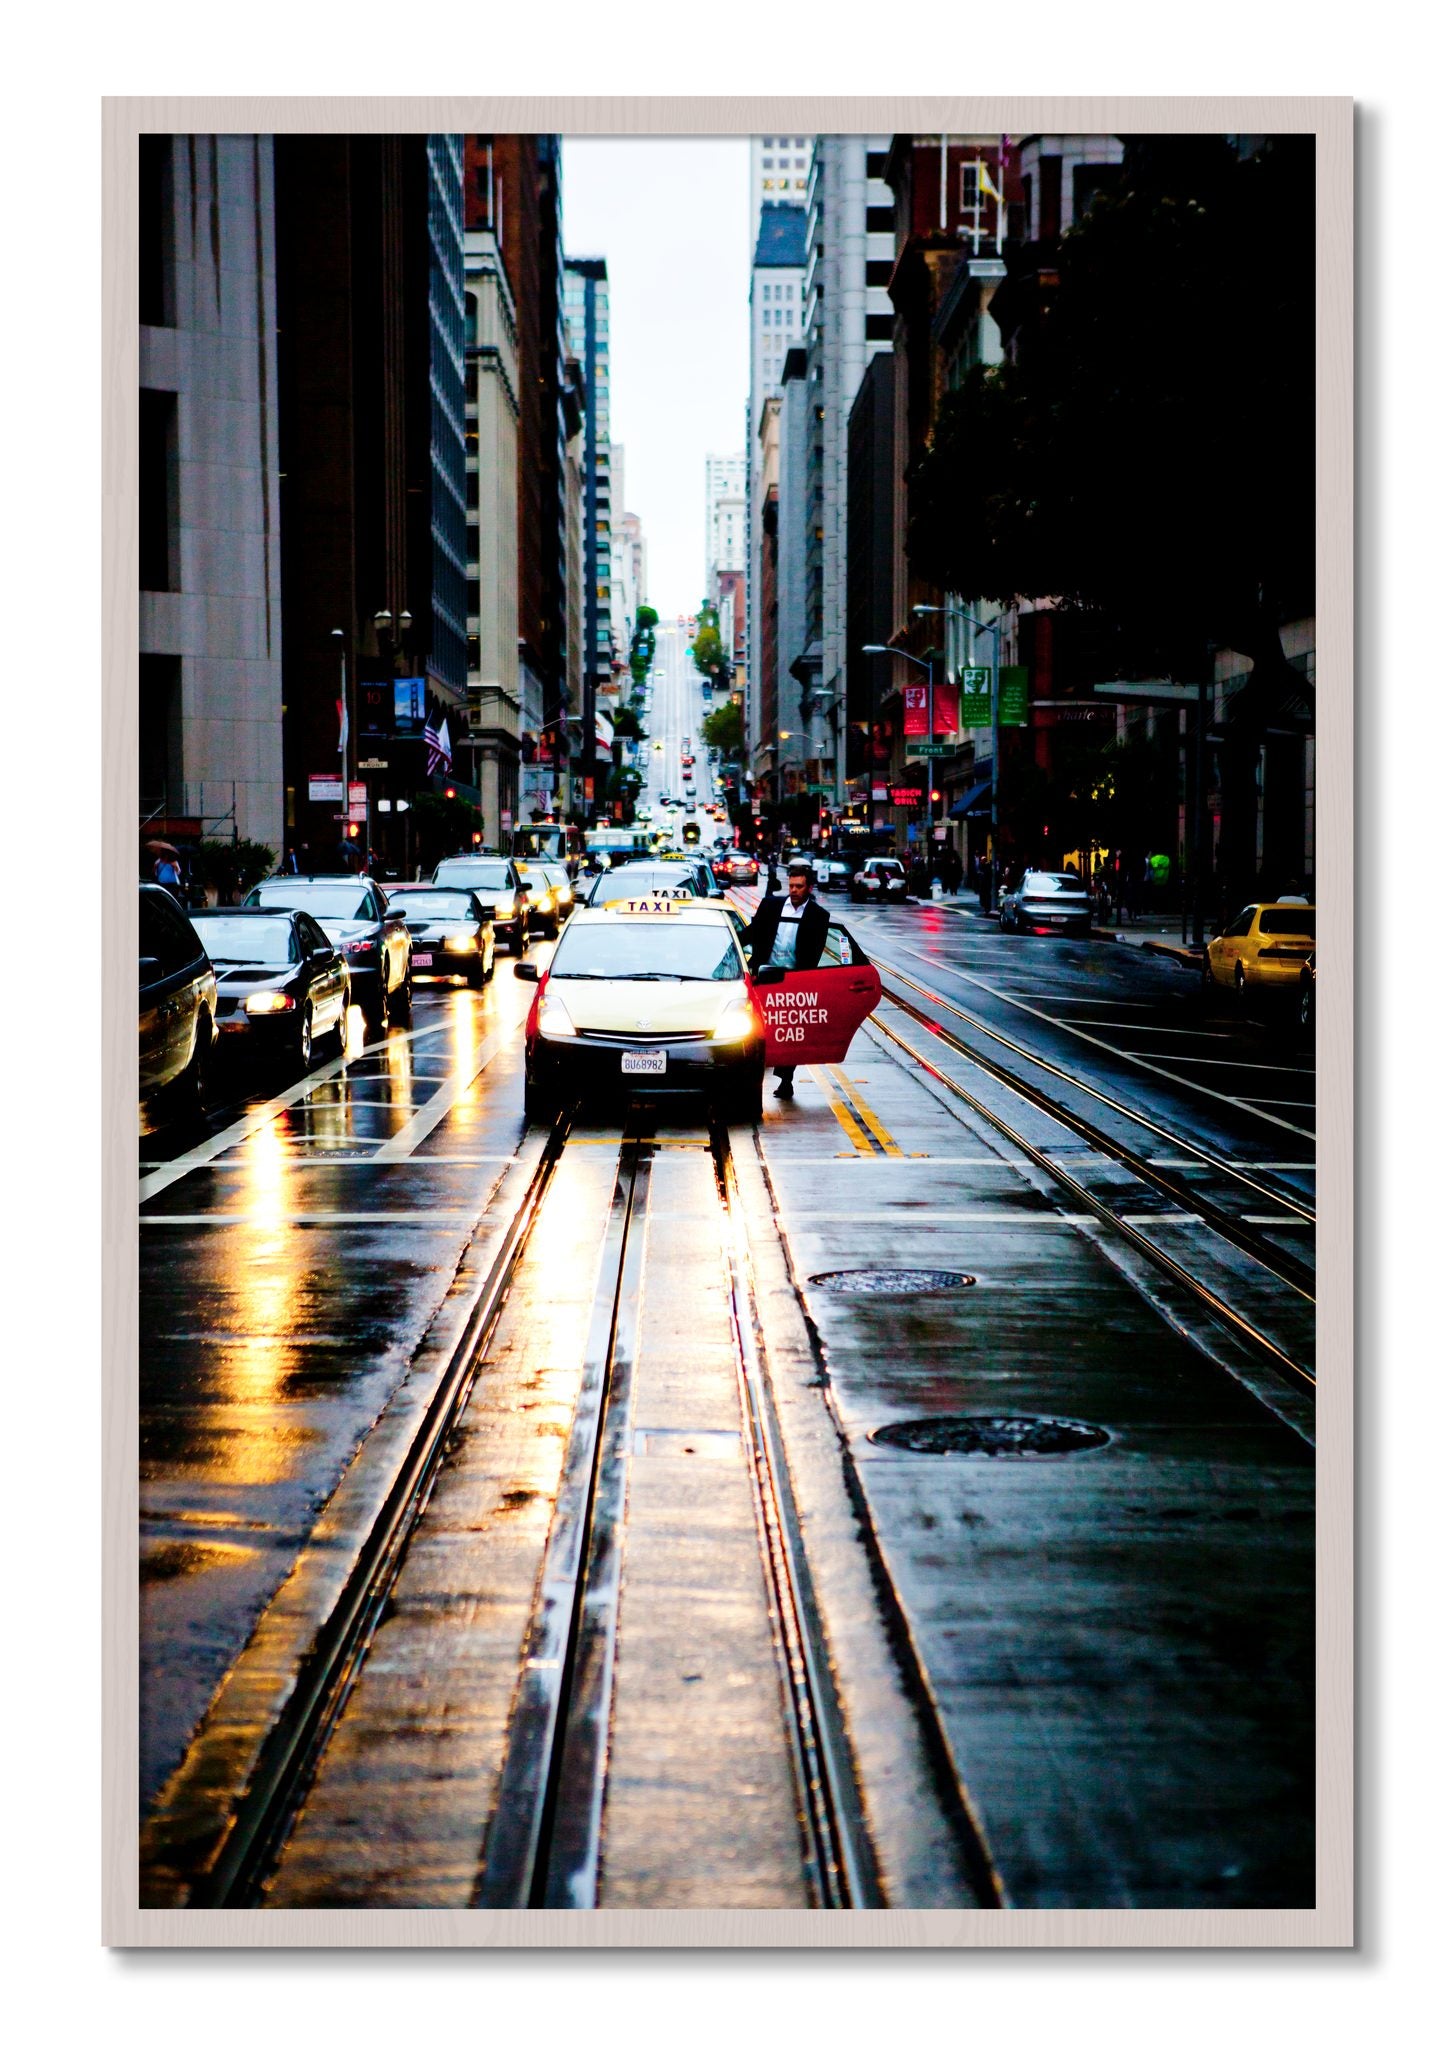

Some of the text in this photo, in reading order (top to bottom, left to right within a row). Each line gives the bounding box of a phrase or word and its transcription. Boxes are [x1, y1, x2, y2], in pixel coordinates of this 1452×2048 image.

[919, 746, 943, 754] Front
[890, 789, 922, 797] TADICH
[894, 798, 918, 806] GRILL
[652, 890, 687, 898] TAXI
[628, 901, 671, 912] TAXI
[765, 991, 818, 1008] ARROW
[774, 1027, 805, 1042] CAB
[624, 1059, 663, 1070] 8U68982
